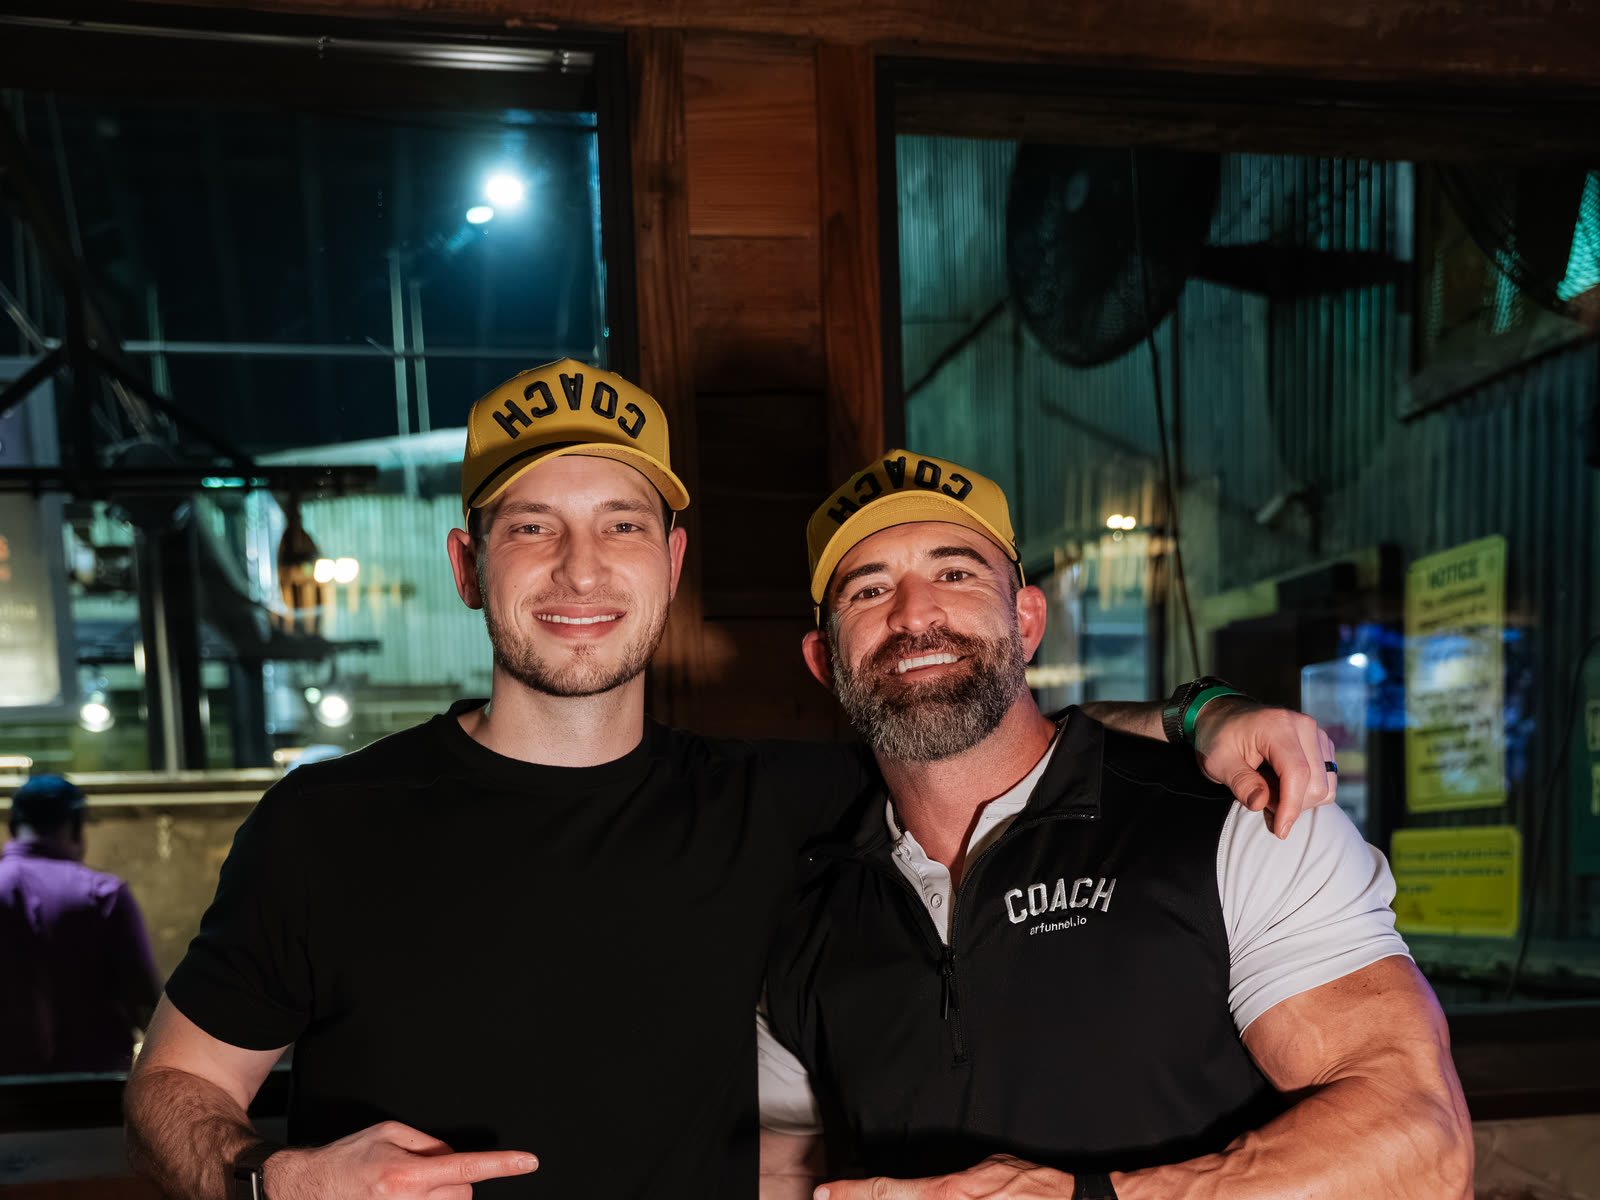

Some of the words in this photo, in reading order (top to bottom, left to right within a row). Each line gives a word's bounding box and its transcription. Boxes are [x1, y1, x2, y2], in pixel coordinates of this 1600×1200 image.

[492, 373, 646, 439] COACH
[1004, 877, 1117, 924] COACH
[1029, 915, 1087, 936] arfunnel.io
